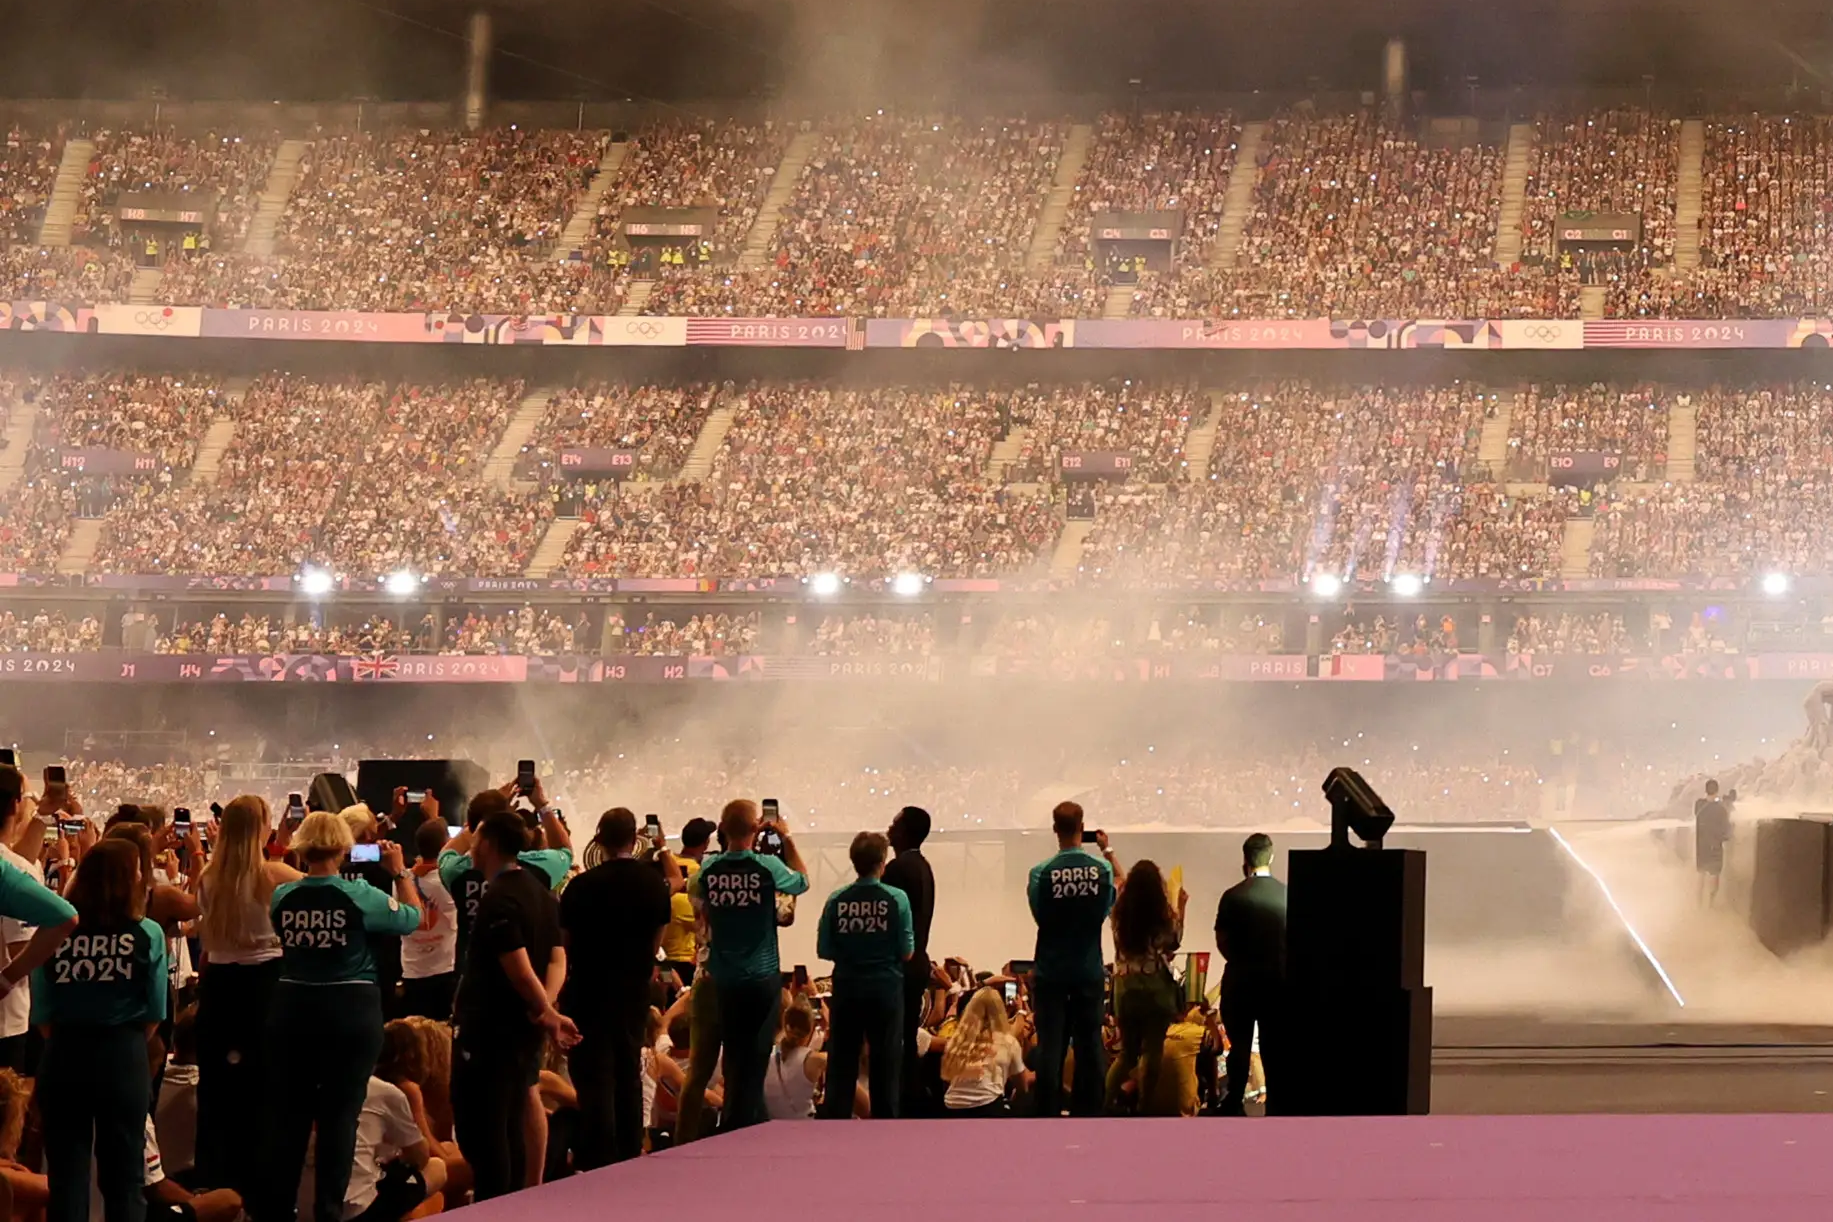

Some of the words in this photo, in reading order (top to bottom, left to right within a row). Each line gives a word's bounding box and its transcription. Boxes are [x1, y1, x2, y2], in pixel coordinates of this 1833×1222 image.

[180, 212, 197, 222] H7
[249, 316, 312, 332] PARIS
[320, 319, 378, 334] 2024
[730, 325, 790, 339] PARIS
[798, 325, 847, 340] 202
[1250, 327, 1303, 341] 2024
[1625, 327, 1684, 341] PARIS
[1692, 326, 1744, 340] 2024
[62, 456, 85, 467] H12
[135, 457, 156, 469] H11
[561, 454, 582, 465] E14
[612, 454, 632, 465] E13
[1062, 457, 1082, 468] E12
[1114, 457, 1131, 468] E11
[1551, 457, 1573, 468] E10
[1604, 457, 1619, 468] E9
[24, 660, 75, 672] 2024
[121, 663, 135, 677] J1
[180, 664, 201, 677] H4
[451, 662, 500, 675] 2024
[606, 666, 625, 679] H3
[664, 666, 684, 679] H2
[831, 662, 883, 675] PARIS
[1250, 662, 1302, 674] PARIS
[1051, 866, 1099, 883] PARIS
[707, 873, 760, 890] PARIS
[1052, 882, 1099, 899] 2024
[709, 890, 761, 906] 2024
[837, 900, 888, 917] PARIS
[281, 909, 346, 929] PARIS
[838, 917, 888, 933] 2024
[284, 930, 347, 948] 2024
[55, 933, 135, 959] PARIS
[55, 958, 133, 984] 2024
